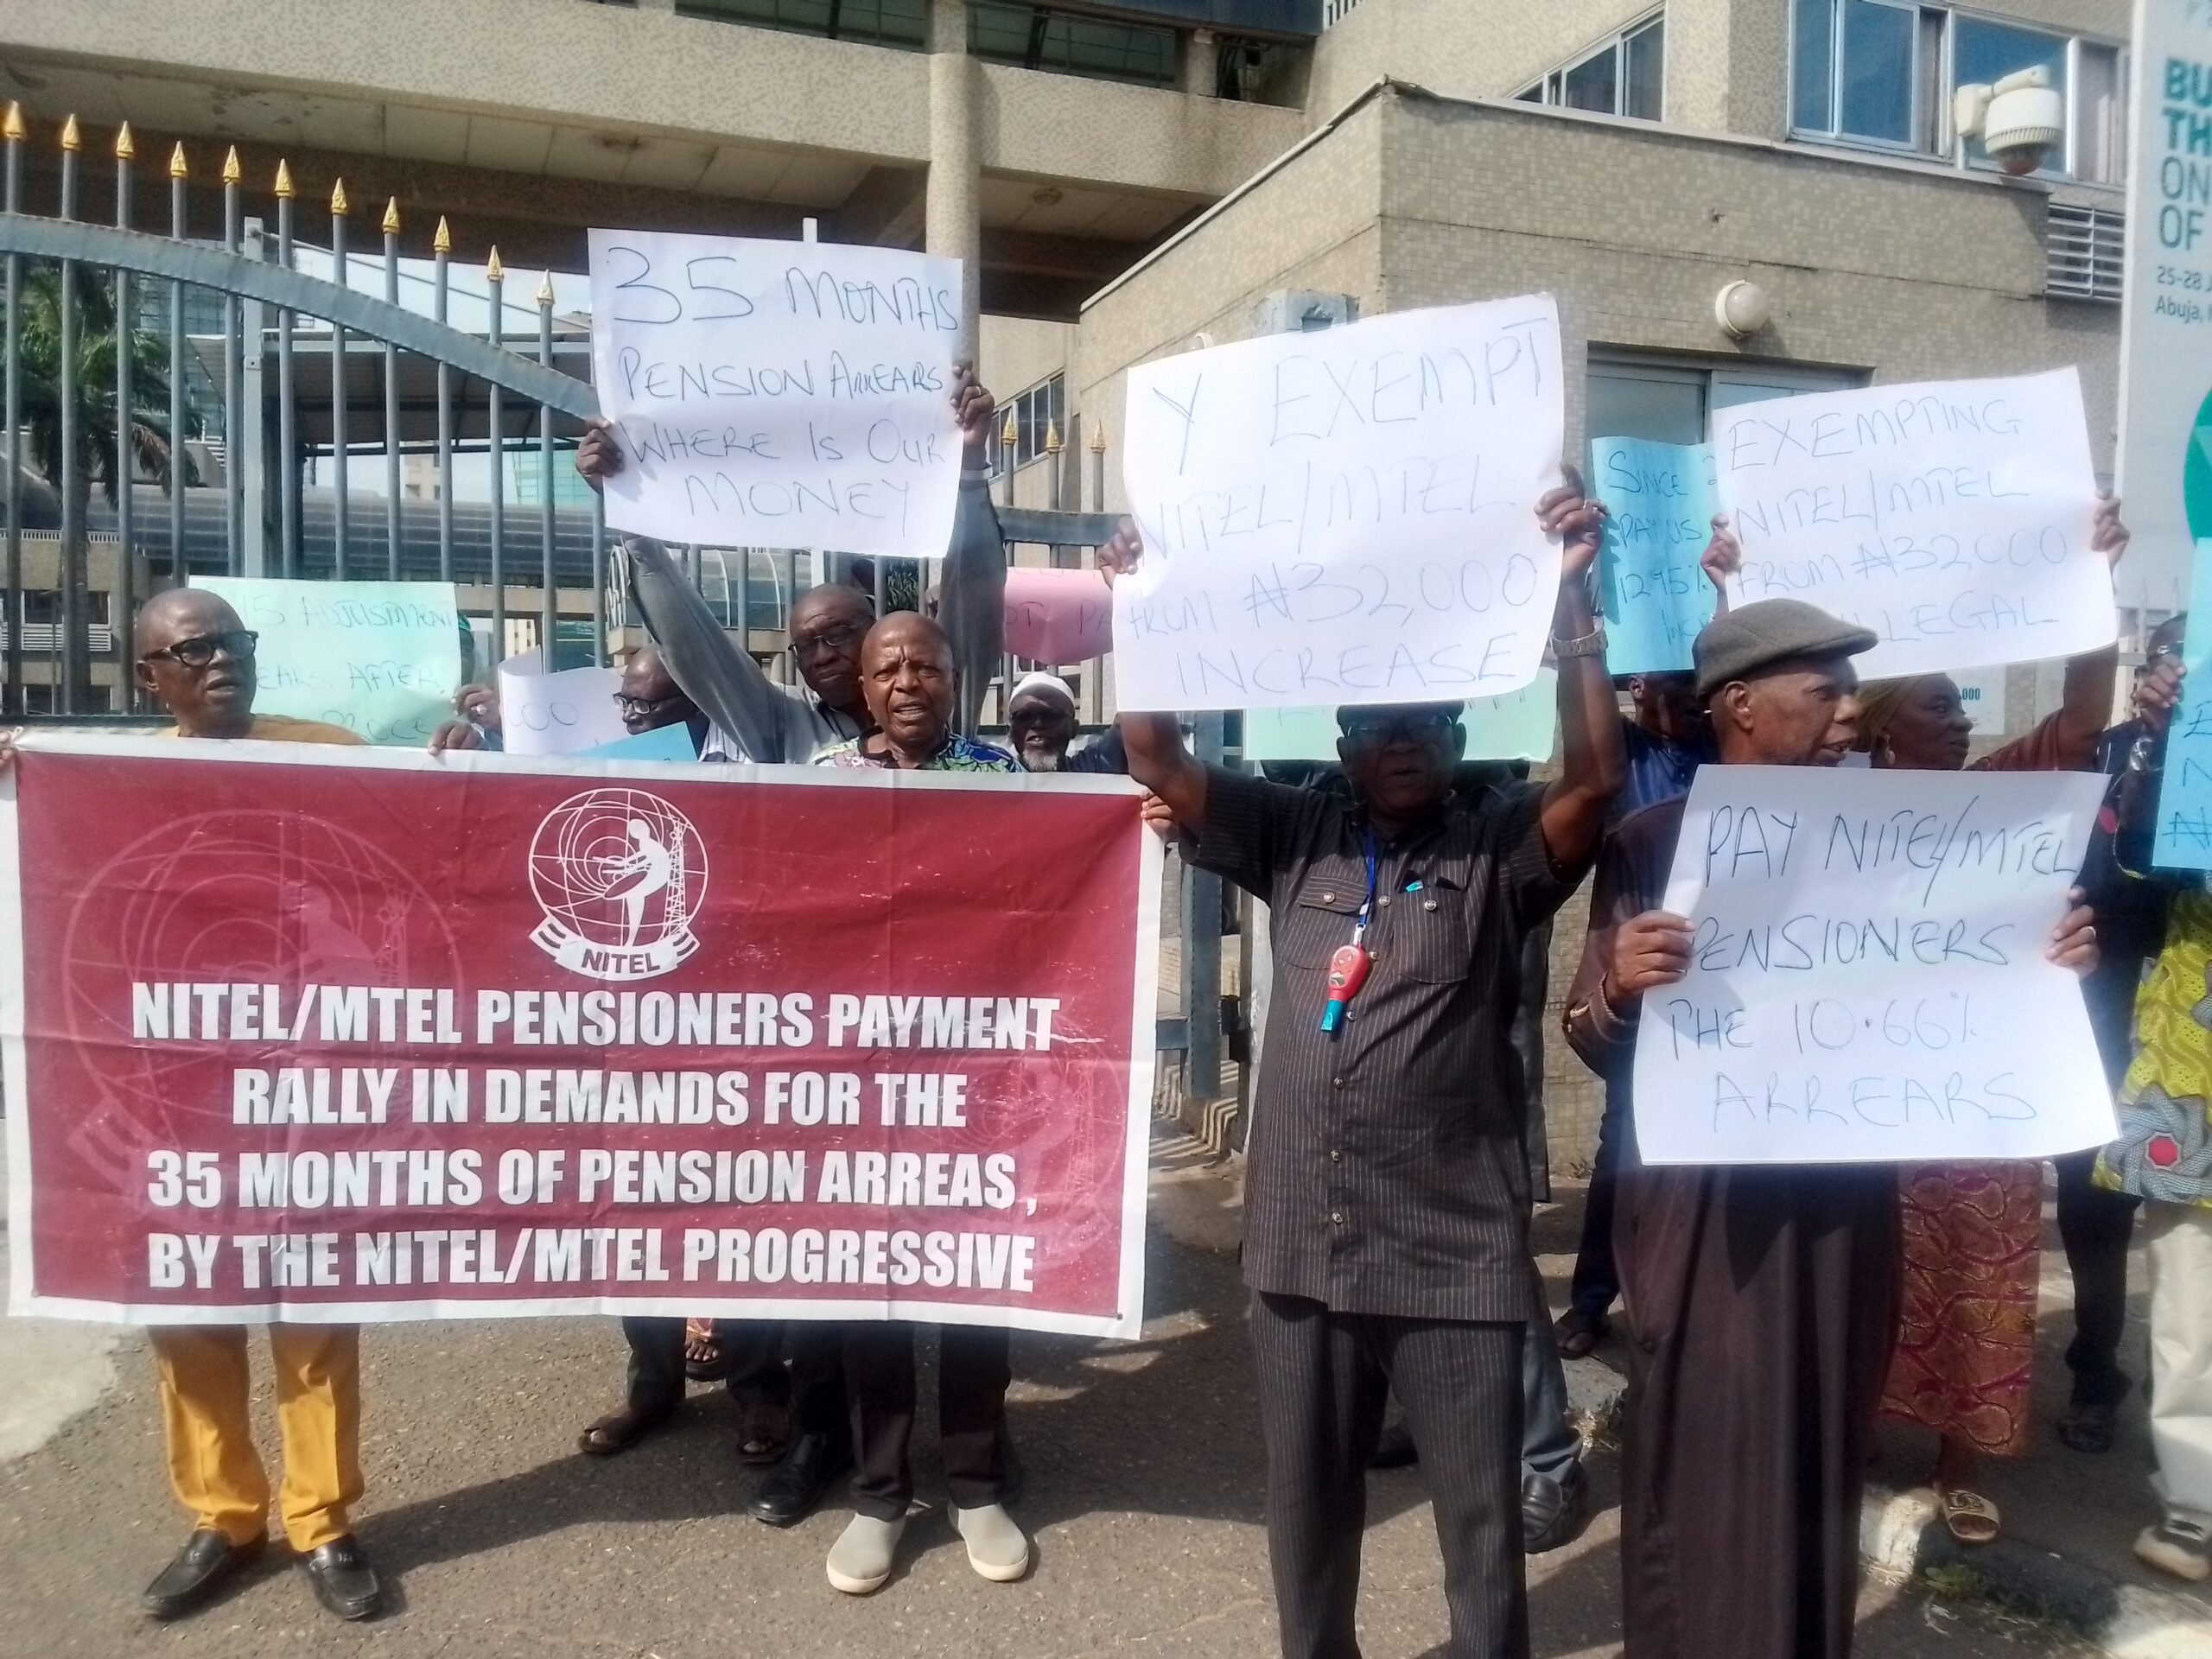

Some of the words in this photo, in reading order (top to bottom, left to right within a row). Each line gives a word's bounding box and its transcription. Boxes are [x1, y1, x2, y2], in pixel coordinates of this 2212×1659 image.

[2159, 204, 2204, 251] OF
[607, 246, 754, 324] 35
[785, 266, 958, 331] MONTHS
[2157, 265, 2202, 291] 25-28
[618, 346, 815, 401] PENSION
[1153, 372, 1202, 475] Y
[1269, 316, 1548, 447] EXEMPT
[619, 420, 781, 463] WHERE
[867, 418, 946, 467] OUR
[1729, 396, 2024, 472] EXEMPTING
[684, 472, 909, 537] MONEY
[1608, 451, 1688, 498] SINCE
[1734, 467, 2031, 545] NITEL/MTEL
[1736, 552, 1845, 598] FROM
[1176, 632, 1518, 695] INCREASE
[1705, 804, 1798, 888] PAY
[581, 948, 660, 974] NITEL
[1688, 914, 2016, 972] PENSIONERS
[131, 982, 462, 1045] NITEL/MTEL
[476, 988, 815, 1047] PENSIONERS
[827, 993, 1061, 1052] PAYMENT
[1668, 999, 1754, 1061] THE
[232, 1068, 399, 1124] RALLY
[412, 1068, 468, 1123] IN
[485, 1069, 750, 1126] DEMANDS
[763, 1071, 861, 1127] FOR
[874, 1072, 968, 1128] THE
[1712, 1071, 2038, 1134] ARREARS
[147, 1149, 222, 1209] 35
[238, 1149, 483, 1208] MONTHS
[498, 1149, 565, 1205] OF
[579, 1149, 805, 1204] PENSION
[148, 1232, 221, 1290] BY
[232, 1232, 340, 1289] THE
[355, 1228, 670, 1286] NITEL/MTEL
[683, 1227, 1036, 1294] PROGRESSIVE
